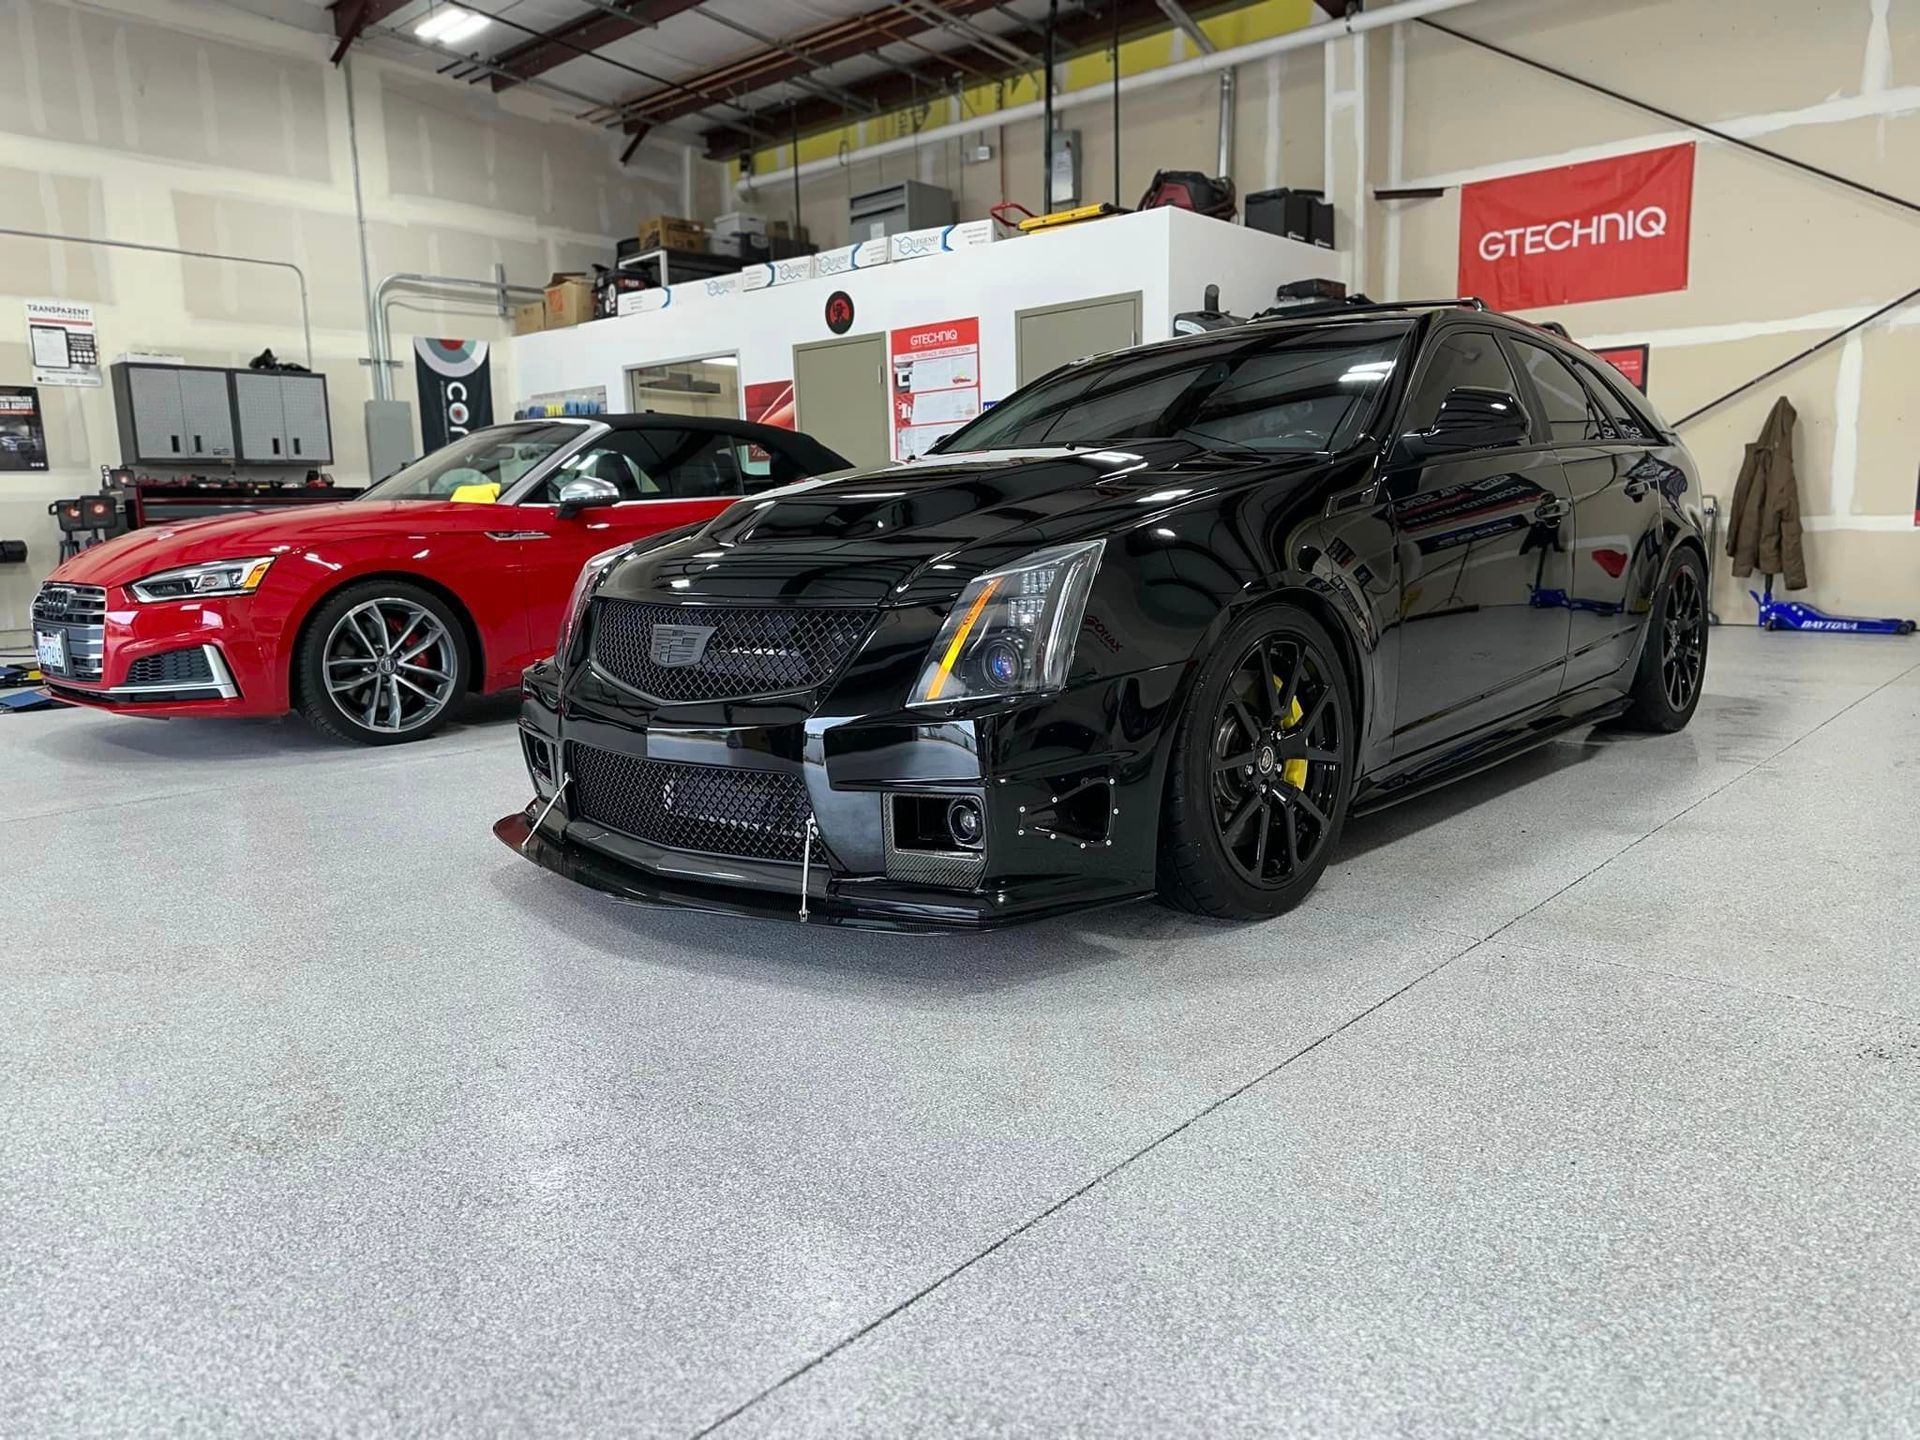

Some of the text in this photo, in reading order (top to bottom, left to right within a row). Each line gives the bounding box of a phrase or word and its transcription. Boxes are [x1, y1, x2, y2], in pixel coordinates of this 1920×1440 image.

[1478, 206, 1667, 261] GTECHNIQ
[27, 304, 90, 316] TRANSPARENT
[910, 329, 958, 346] GTECHNIQ
[1801, 620, 1858, 630] DAYTONA
